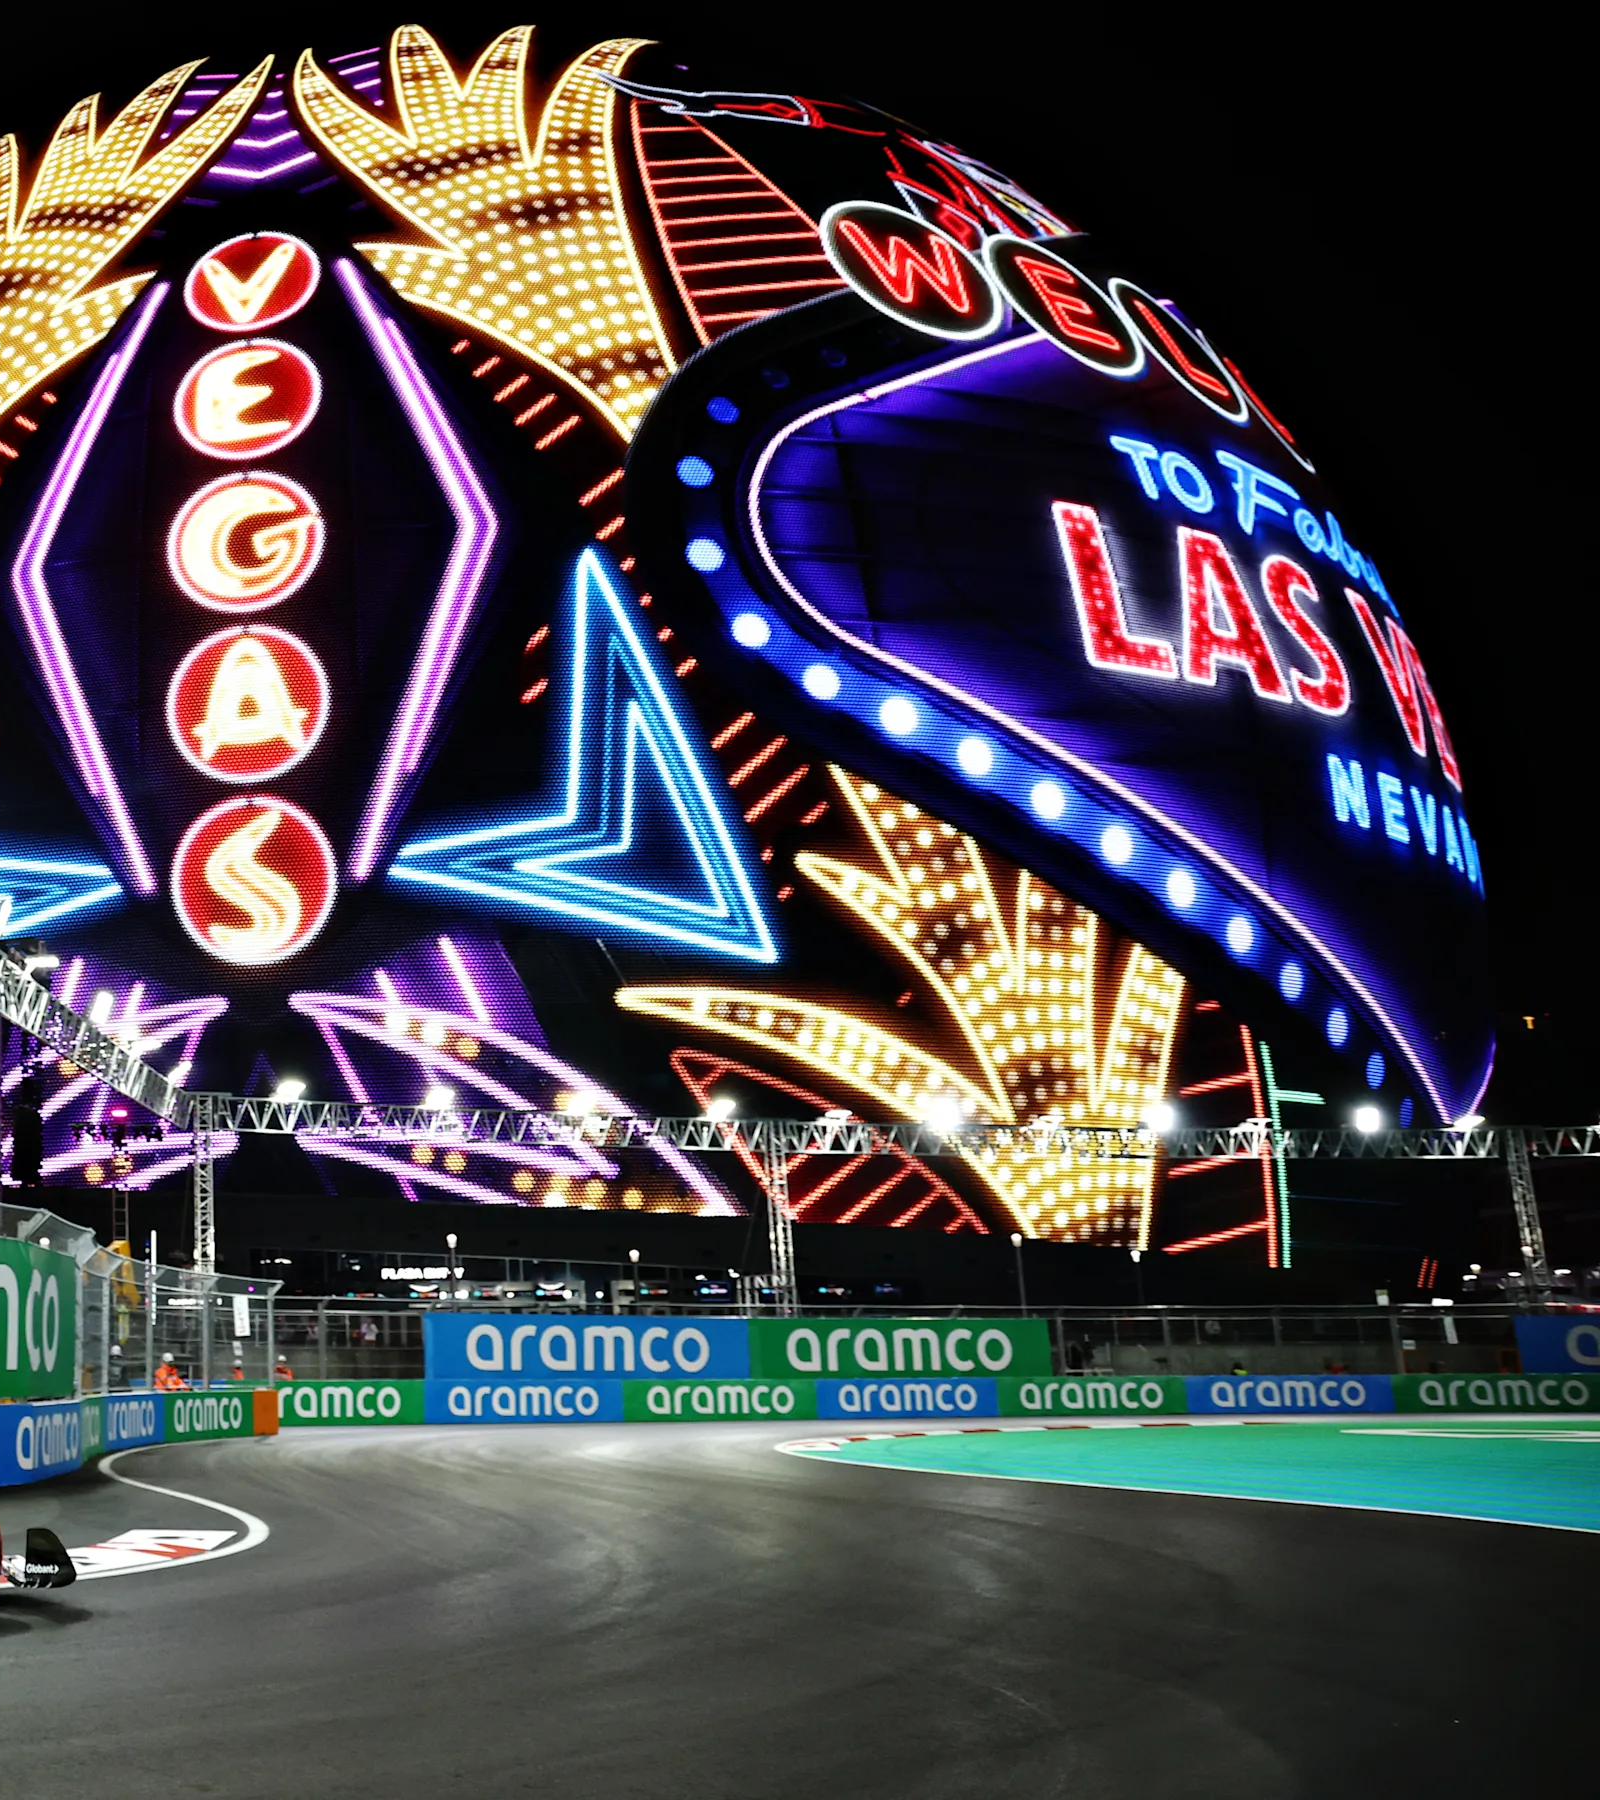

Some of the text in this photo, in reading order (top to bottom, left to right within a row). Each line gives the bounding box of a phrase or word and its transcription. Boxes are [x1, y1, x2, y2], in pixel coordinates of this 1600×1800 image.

[836, 218, 1296, 444] WEL
[1109, 435, 1214, 515] TO
[180, 240, 318, 958] VEGAS
[1052, 500, 1351, 716] LAS
[466, 1323, 710, 1373] aramco
[786, 1328, 1013, 1373] aramco
[277, 1385, 402, 1419] ramco
[447, 1385, 599, 1417] aramco
[646, 1384, 796, 1415] aramco
[837, 1382, 979, 1413] aramco
[1018, 1380, 1164, 1410] aramco
[1209, 1379, 1367, 1408] aramco
[1418, 1379, 1591, 1407] aramco
[173, 1396, 243, 1434] aramco
[16, 1411, 79, 1471] aramco
